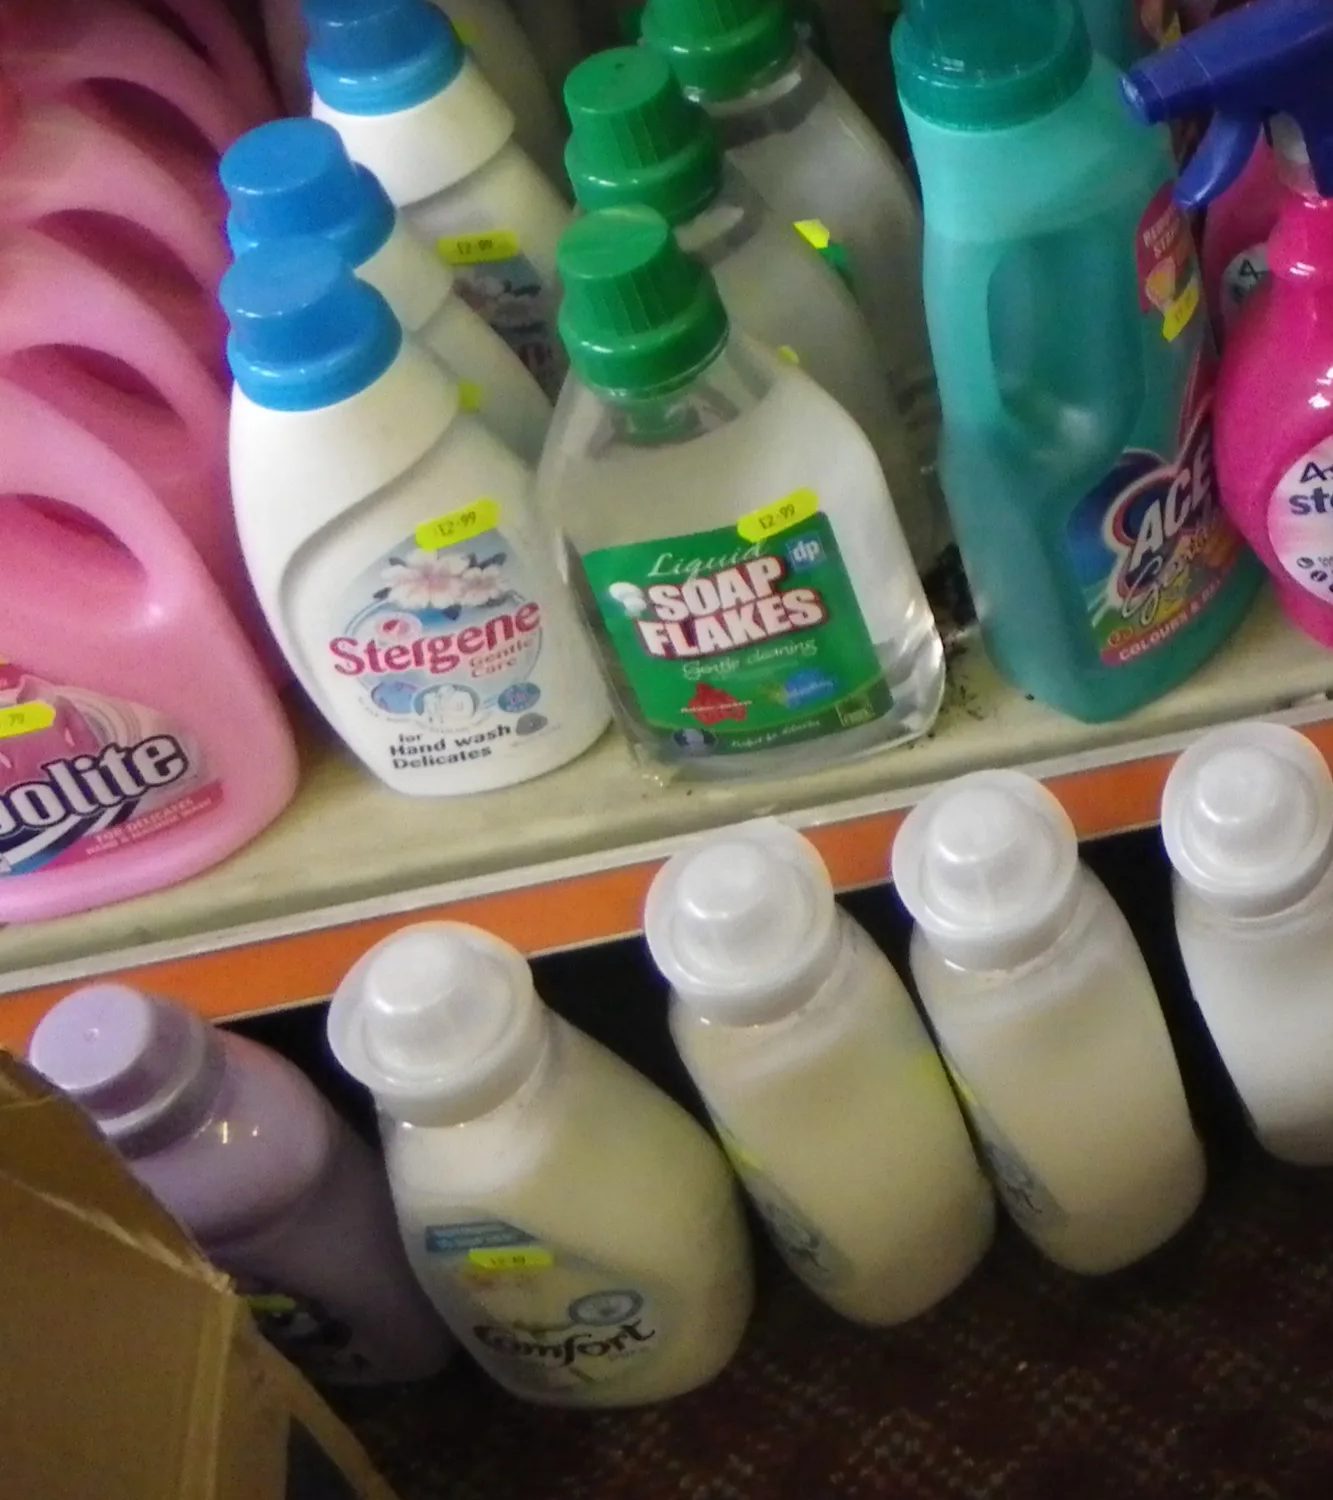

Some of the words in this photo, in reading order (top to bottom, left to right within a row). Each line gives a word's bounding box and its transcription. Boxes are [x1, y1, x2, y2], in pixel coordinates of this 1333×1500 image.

[793, 536, 820, 562] dp
[648, 556, 786, 622] SOAP
[329, 603, 541, 676] Stergene
[637, 588, 824, 659] FLAKES
[1119, 613, 1194, 662] COLOURS
[747, 639, 818, 666] cleaning
[390, 738, 446, 757] Hand
[455, 723, 511, 748] wash
[393, 745, 492, 770] Delicates
[0, 734, 189, 835] olite
[128, 798, 194, 835] DELICATES
[474, 1320, 656, 1364] Comfort
